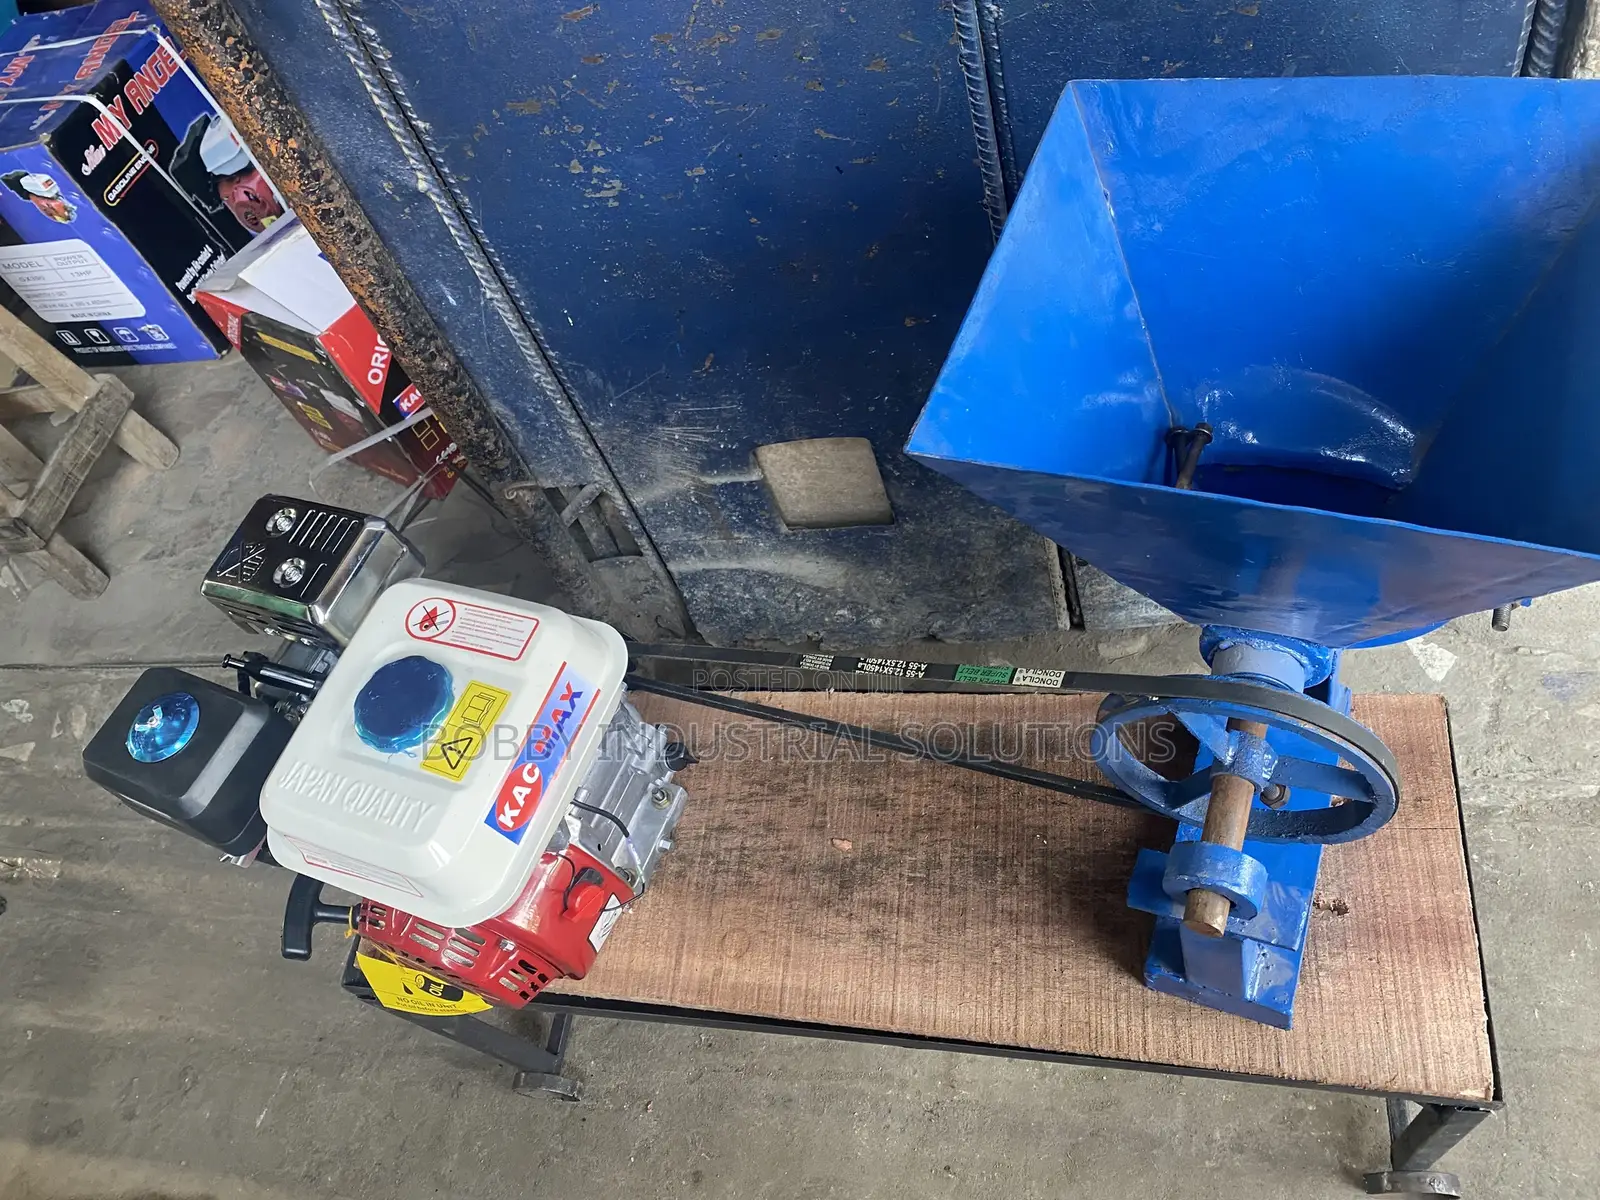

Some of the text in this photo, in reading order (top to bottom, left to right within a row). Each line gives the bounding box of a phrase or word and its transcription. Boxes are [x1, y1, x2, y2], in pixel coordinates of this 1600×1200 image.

[75, 11, 140, 80] ANGEL
[91, 94, 132, 151] MY
[107, 144, 156, 202] GASOLINE ENGNE
[2, 260, 45, 270] MODEL
[56, 259, 89, 267] OUTPUT
[905, 669, 925, 679] A-55
[959, 666, 983, 676] BELT
[982, 669, 1007, 679] SUPER
[1022, 675, 1058, 687] DONCILA
[279, 760, 437, 834] JAPAN QUALITY
[498, 762, 541, 829] KAC
[429, 983, 445, 997] OIL
[396, 996, 410, 1004] NO
